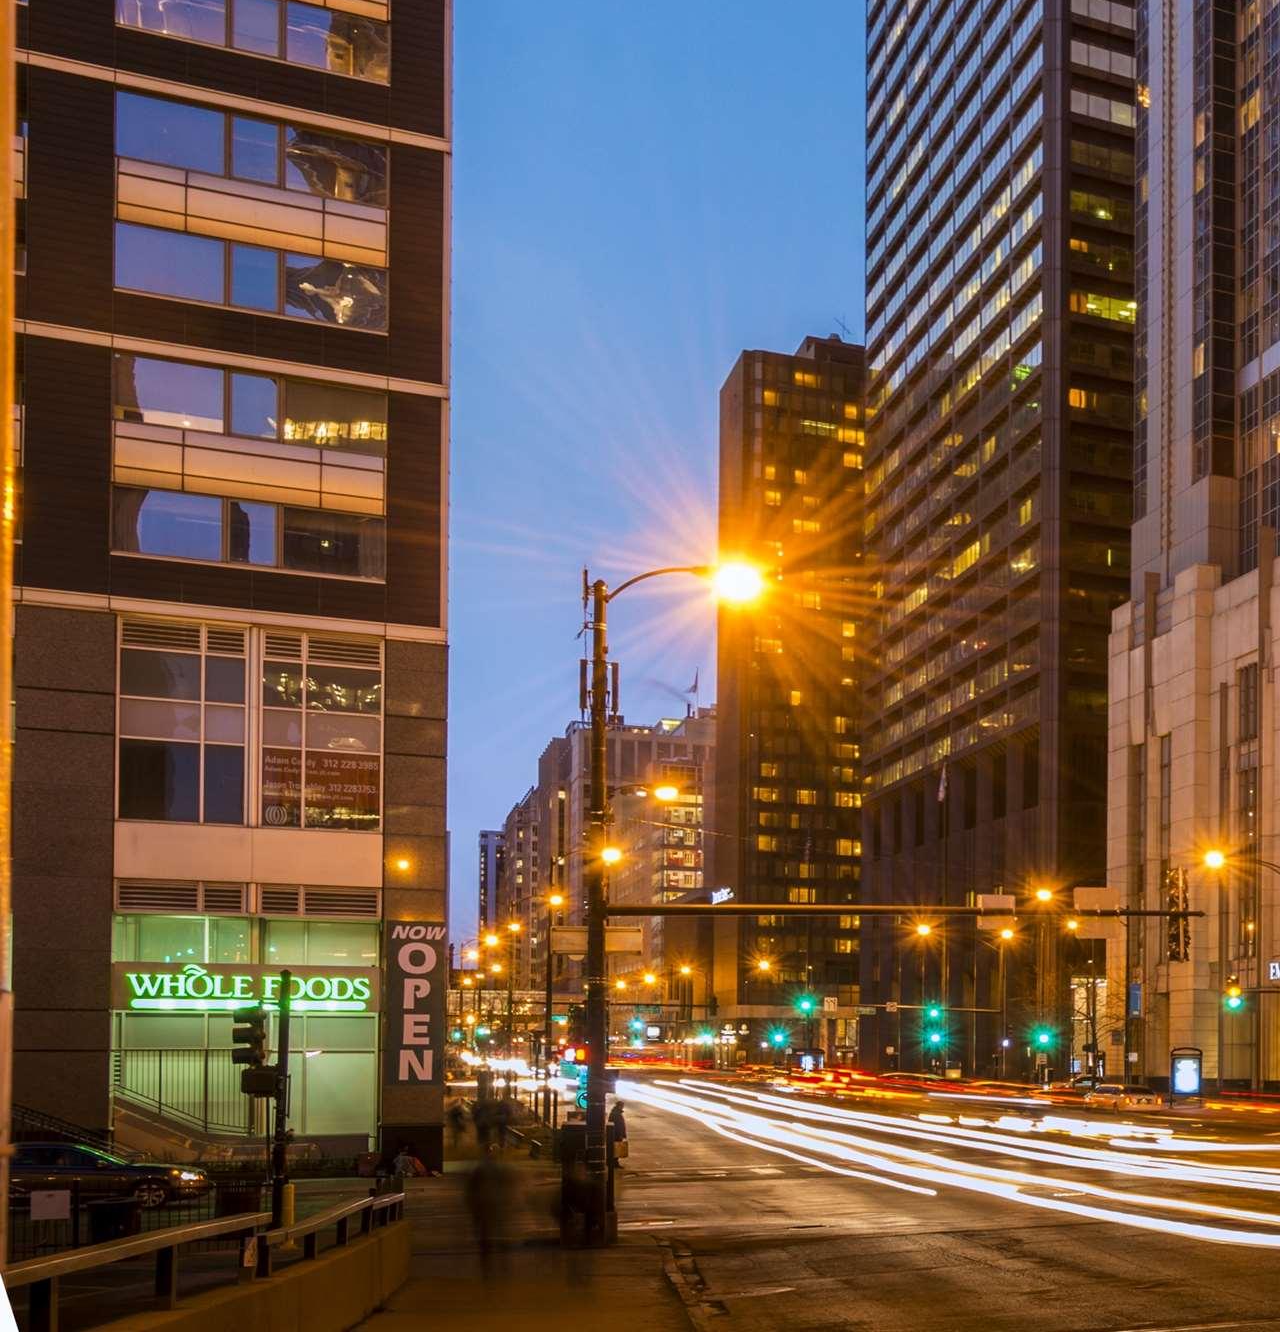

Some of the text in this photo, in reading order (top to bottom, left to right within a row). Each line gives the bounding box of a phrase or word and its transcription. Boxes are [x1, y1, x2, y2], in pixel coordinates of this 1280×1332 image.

[392, 925, 446, 940] NOW
[126, 965, 371, 1001] WHOLE FOODS
[398, 942, 437, 1081] OPEN
